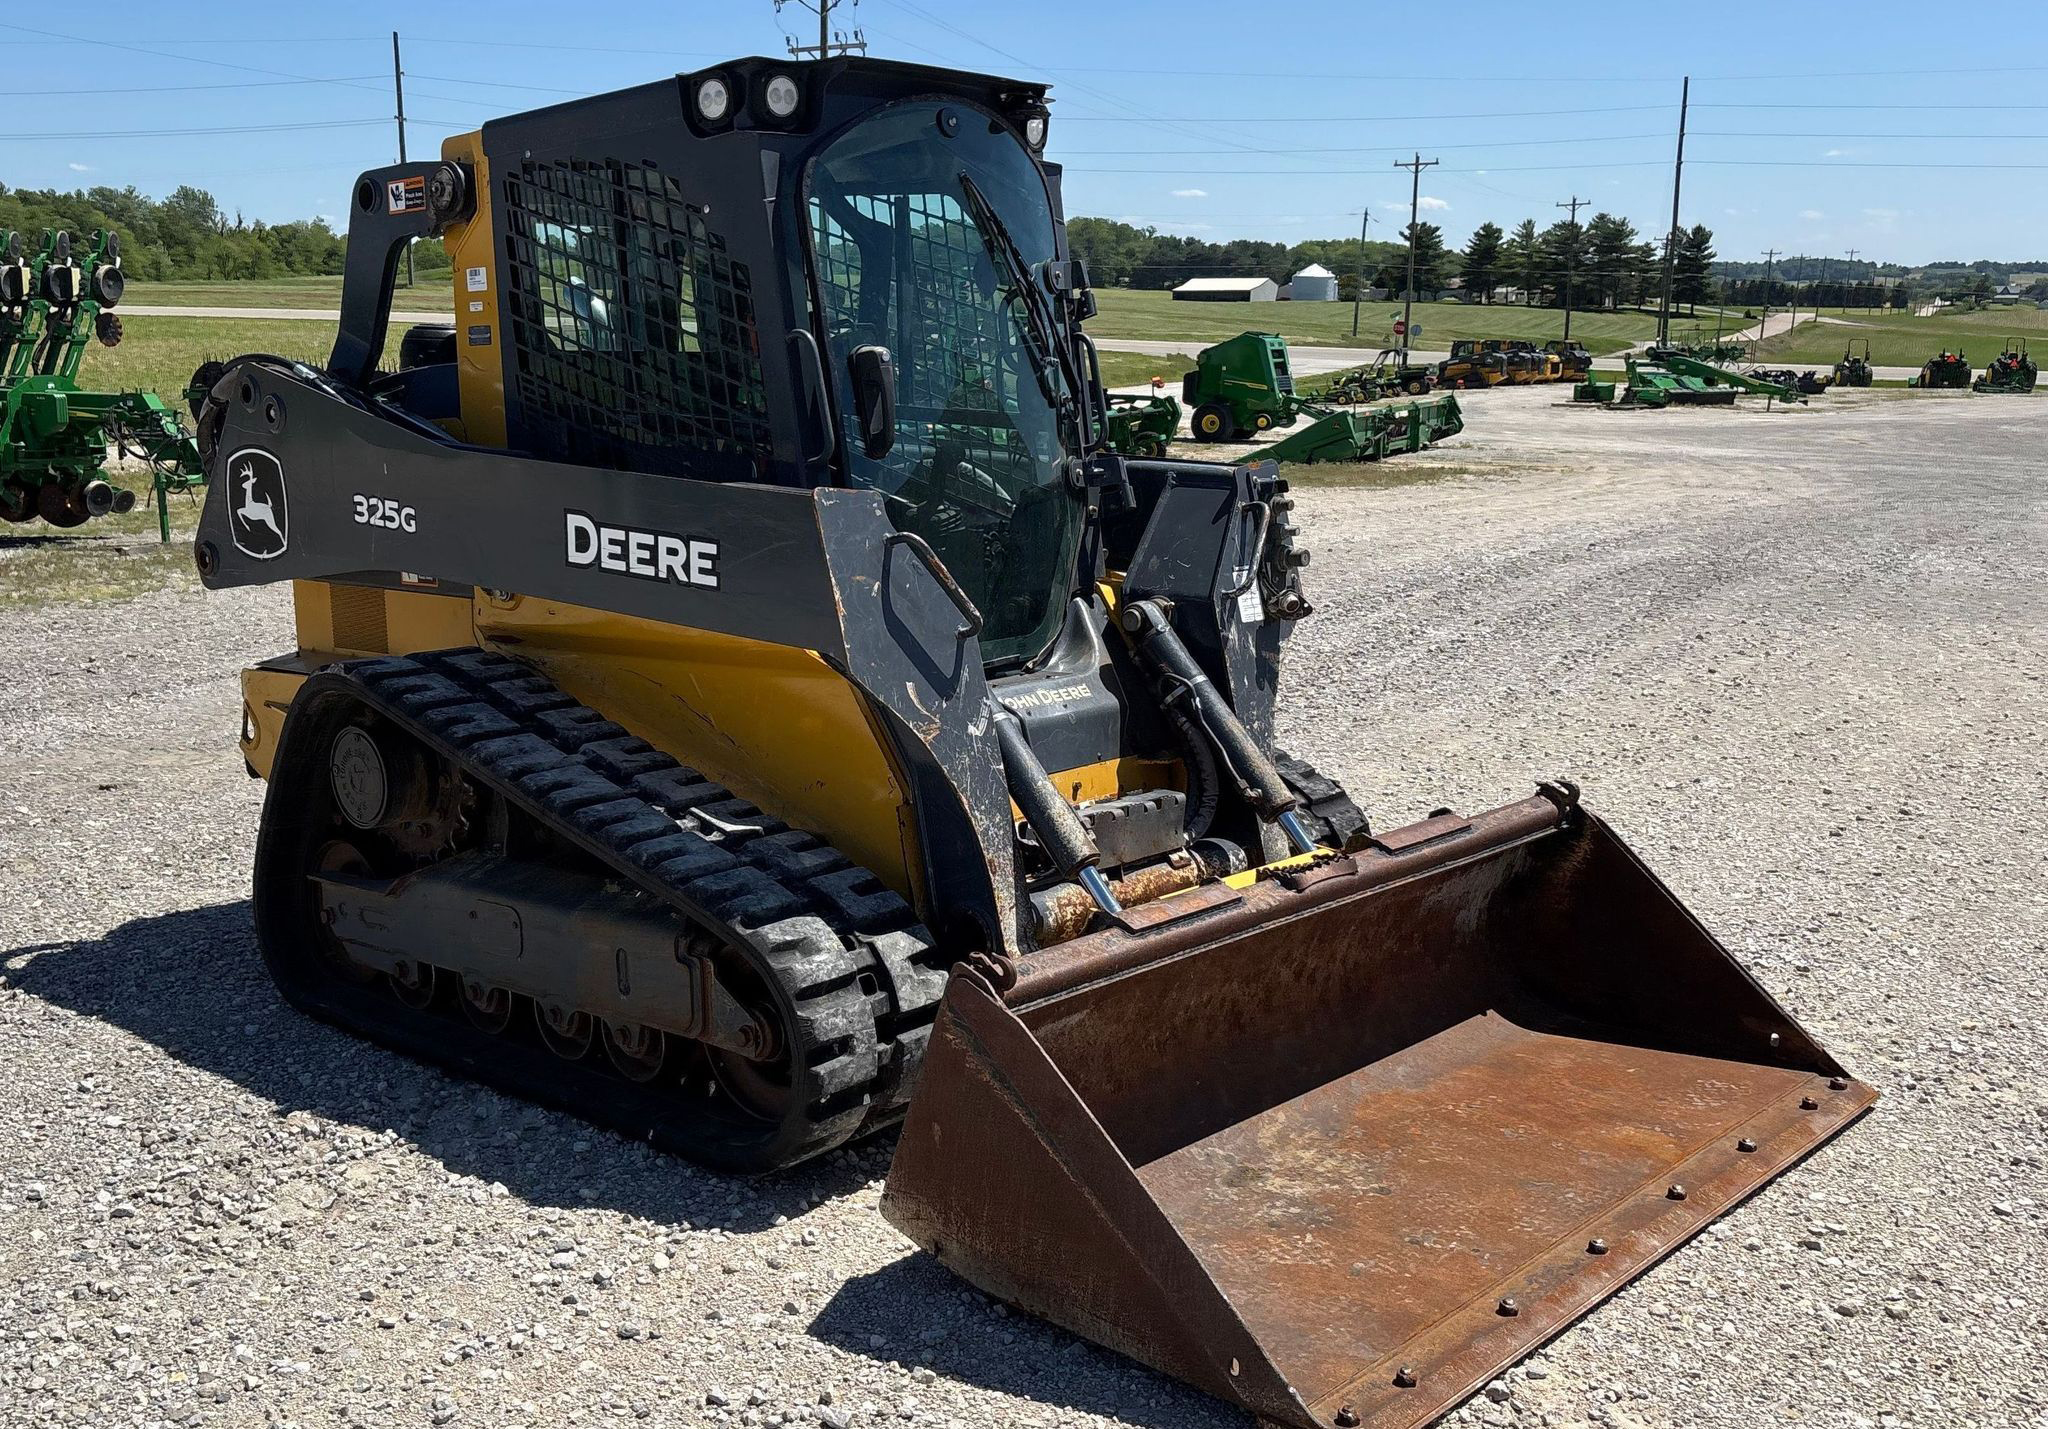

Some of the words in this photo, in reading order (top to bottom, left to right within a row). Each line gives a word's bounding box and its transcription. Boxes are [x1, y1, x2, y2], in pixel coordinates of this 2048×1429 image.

[353, 494, 417, 533] 325G
[566, 512, 718, 588] DEERE
[1036, 683, 1093, 705] DEERE
